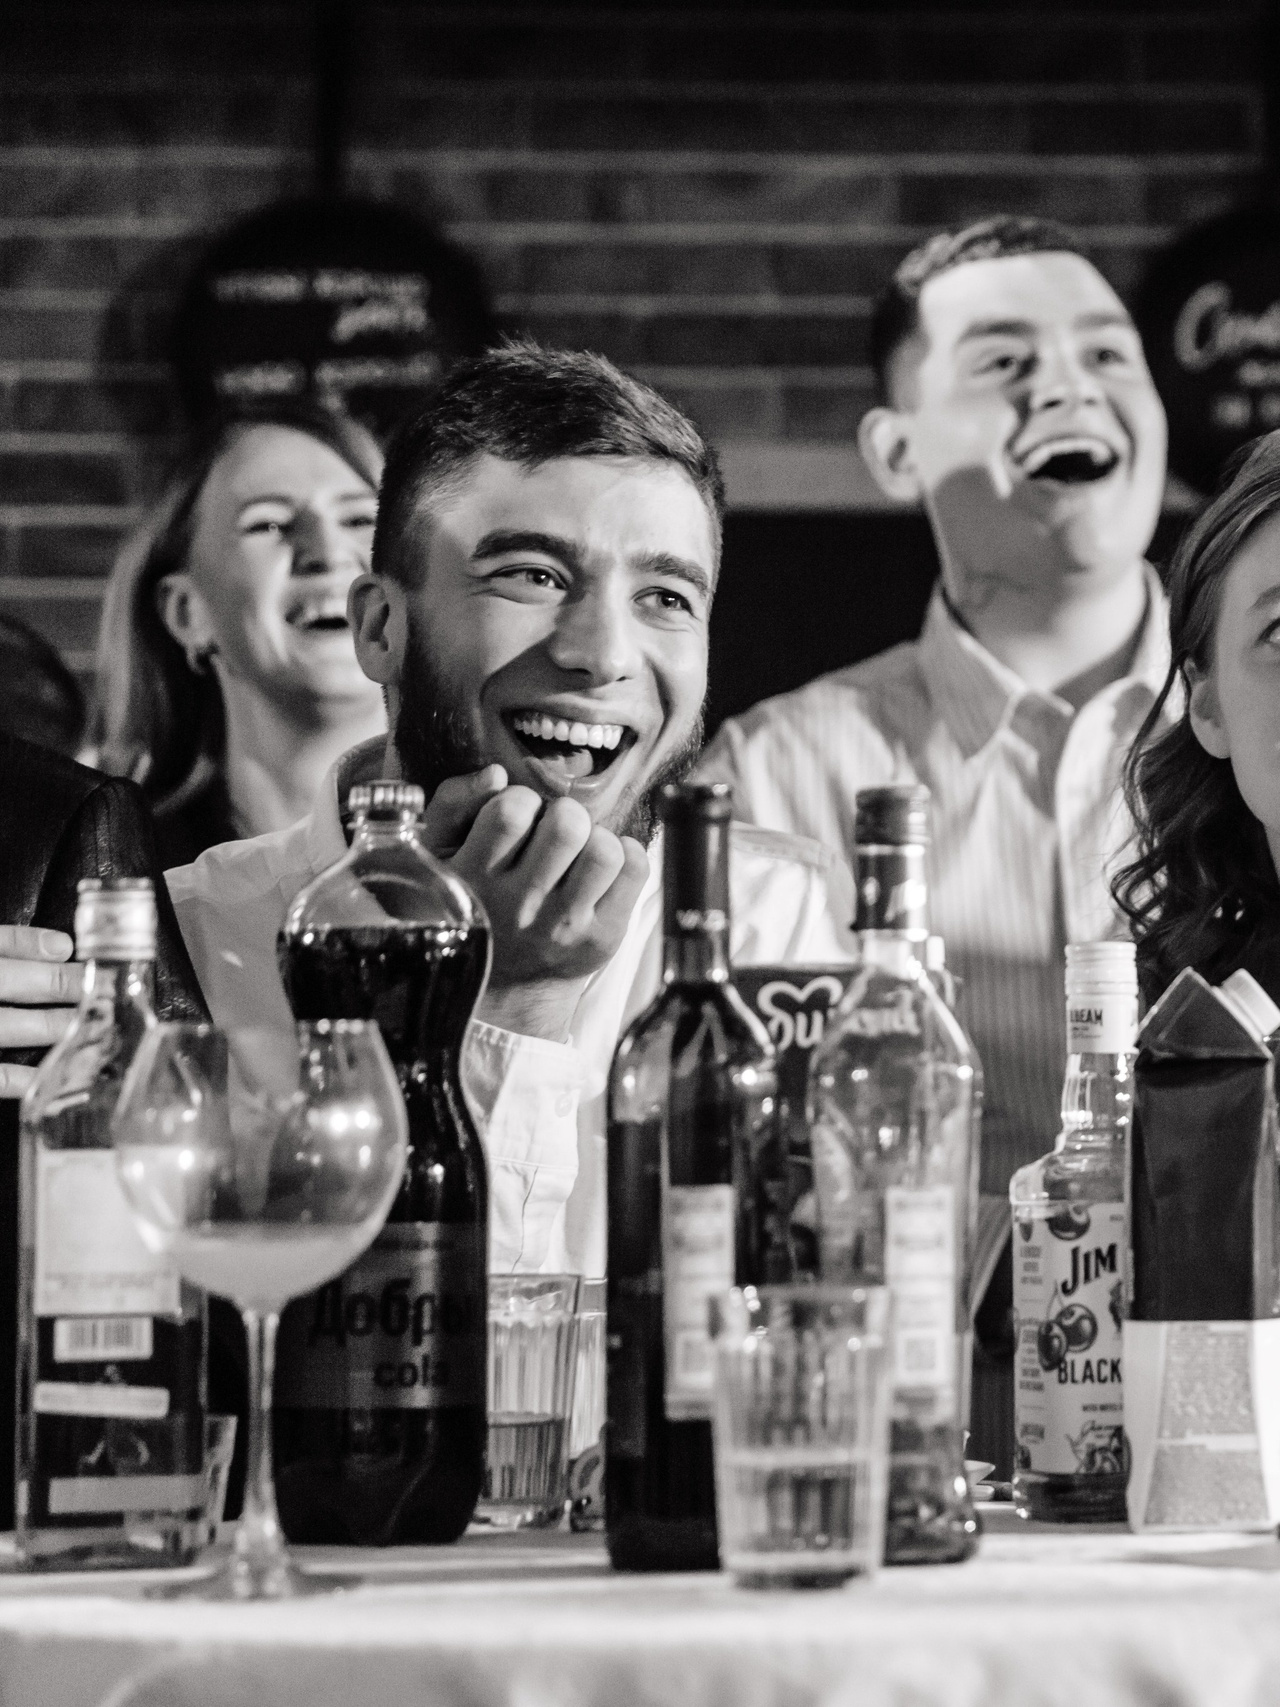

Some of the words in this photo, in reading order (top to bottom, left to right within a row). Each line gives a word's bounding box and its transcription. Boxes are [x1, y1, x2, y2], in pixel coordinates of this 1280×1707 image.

[1061, 1242, 1117, 1297] JIM
[374, 1355, 451, 1388] cola
[1058, 1357, 1122, 1384] BLACK
